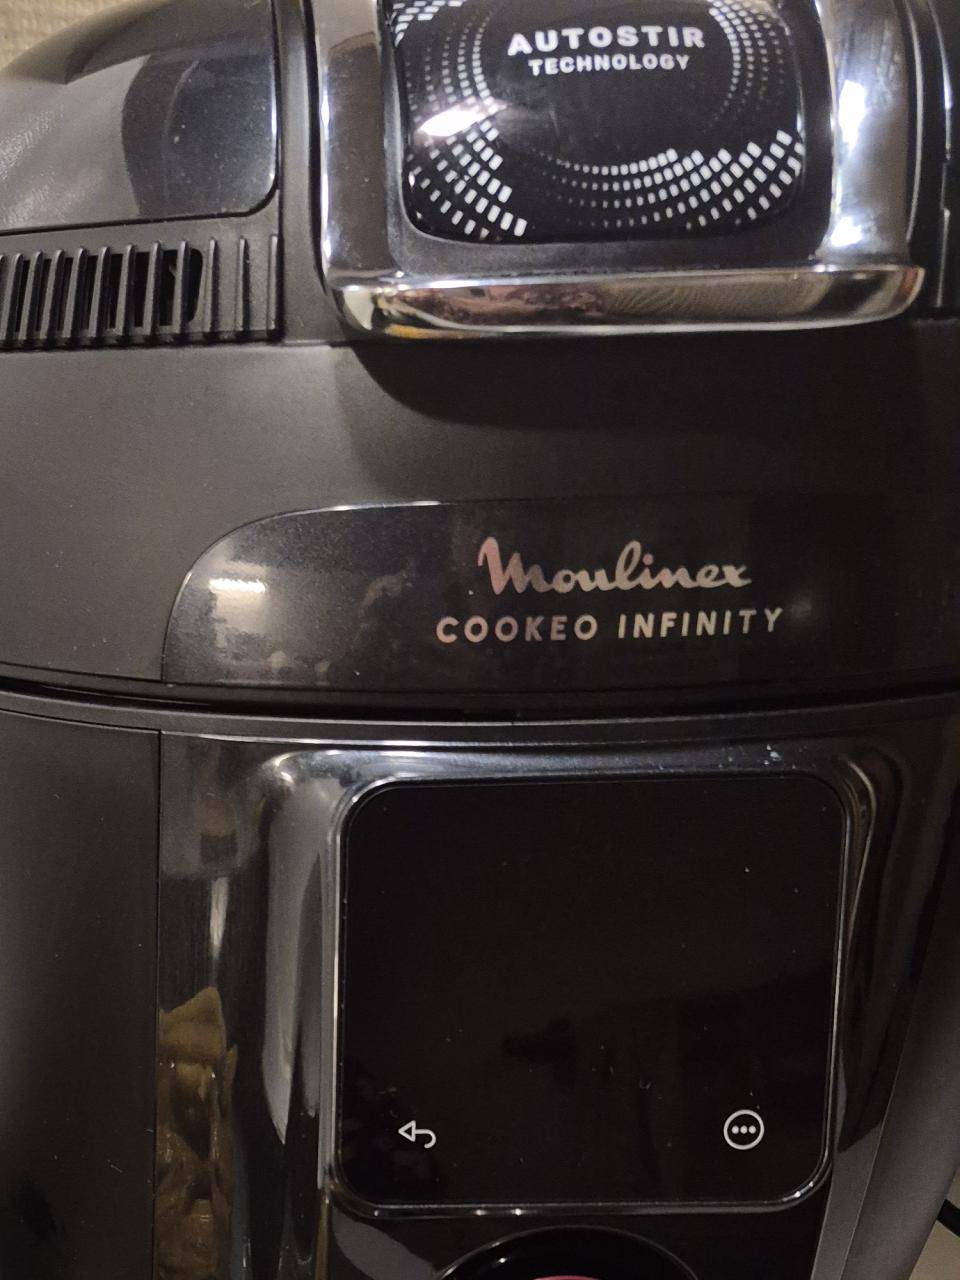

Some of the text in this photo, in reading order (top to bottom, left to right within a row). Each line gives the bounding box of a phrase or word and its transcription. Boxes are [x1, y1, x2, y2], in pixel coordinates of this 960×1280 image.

[507, 25, 706, 57] AUTOSTIR
[528, 52, 691, 77] TECHNOLOGY
[477, 536, 752, 595] Moulinex
[436, 607, 783, 644] COOKEO INFINITY
